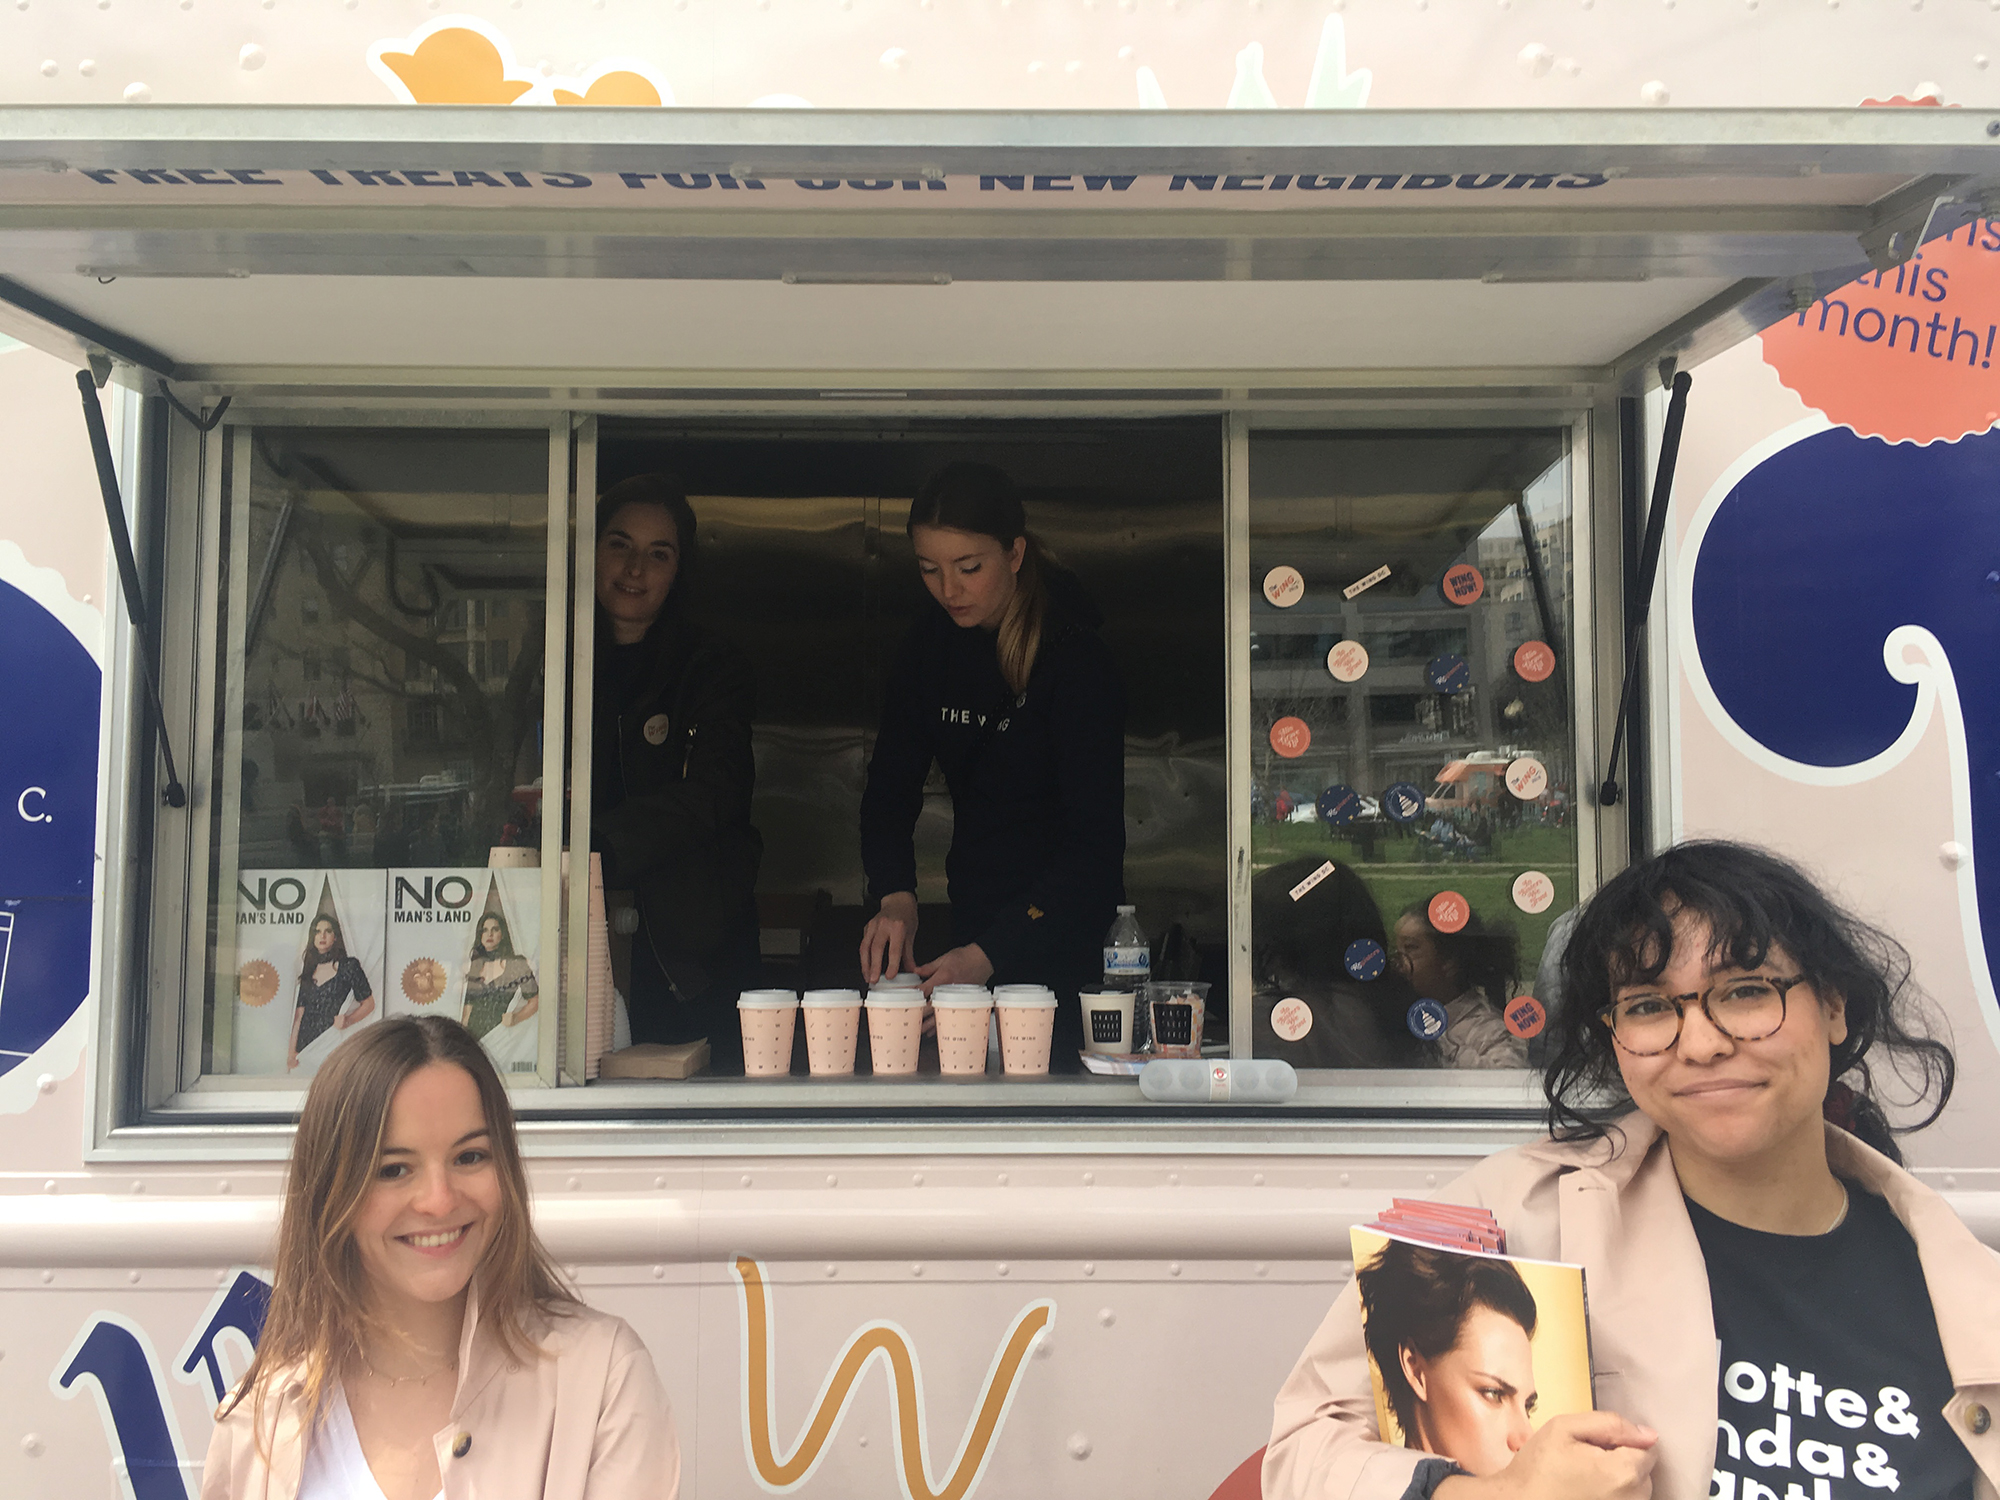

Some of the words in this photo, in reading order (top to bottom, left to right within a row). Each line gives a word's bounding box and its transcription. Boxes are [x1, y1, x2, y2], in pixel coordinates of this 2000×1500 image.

[1271, 575, 1295, 600] WING
[1449, 571, 1475, 587] WING
[1454, 581, 1478, 598] NOW!
[941, 706, 970, 724] THE
[1515, 765, 1537, 793] WING
[394, 876, 473, 909] NO
[236, 912, 267, 925] AN'S
[269, 912, 305, 925] LAND
[394, 910, 433, 923] MAN'S
[436, 910, 472, 923] LAND
[1510, 1002, 1535, 1022] WING
[1516, 1010, 1540, 1032] NOW!
